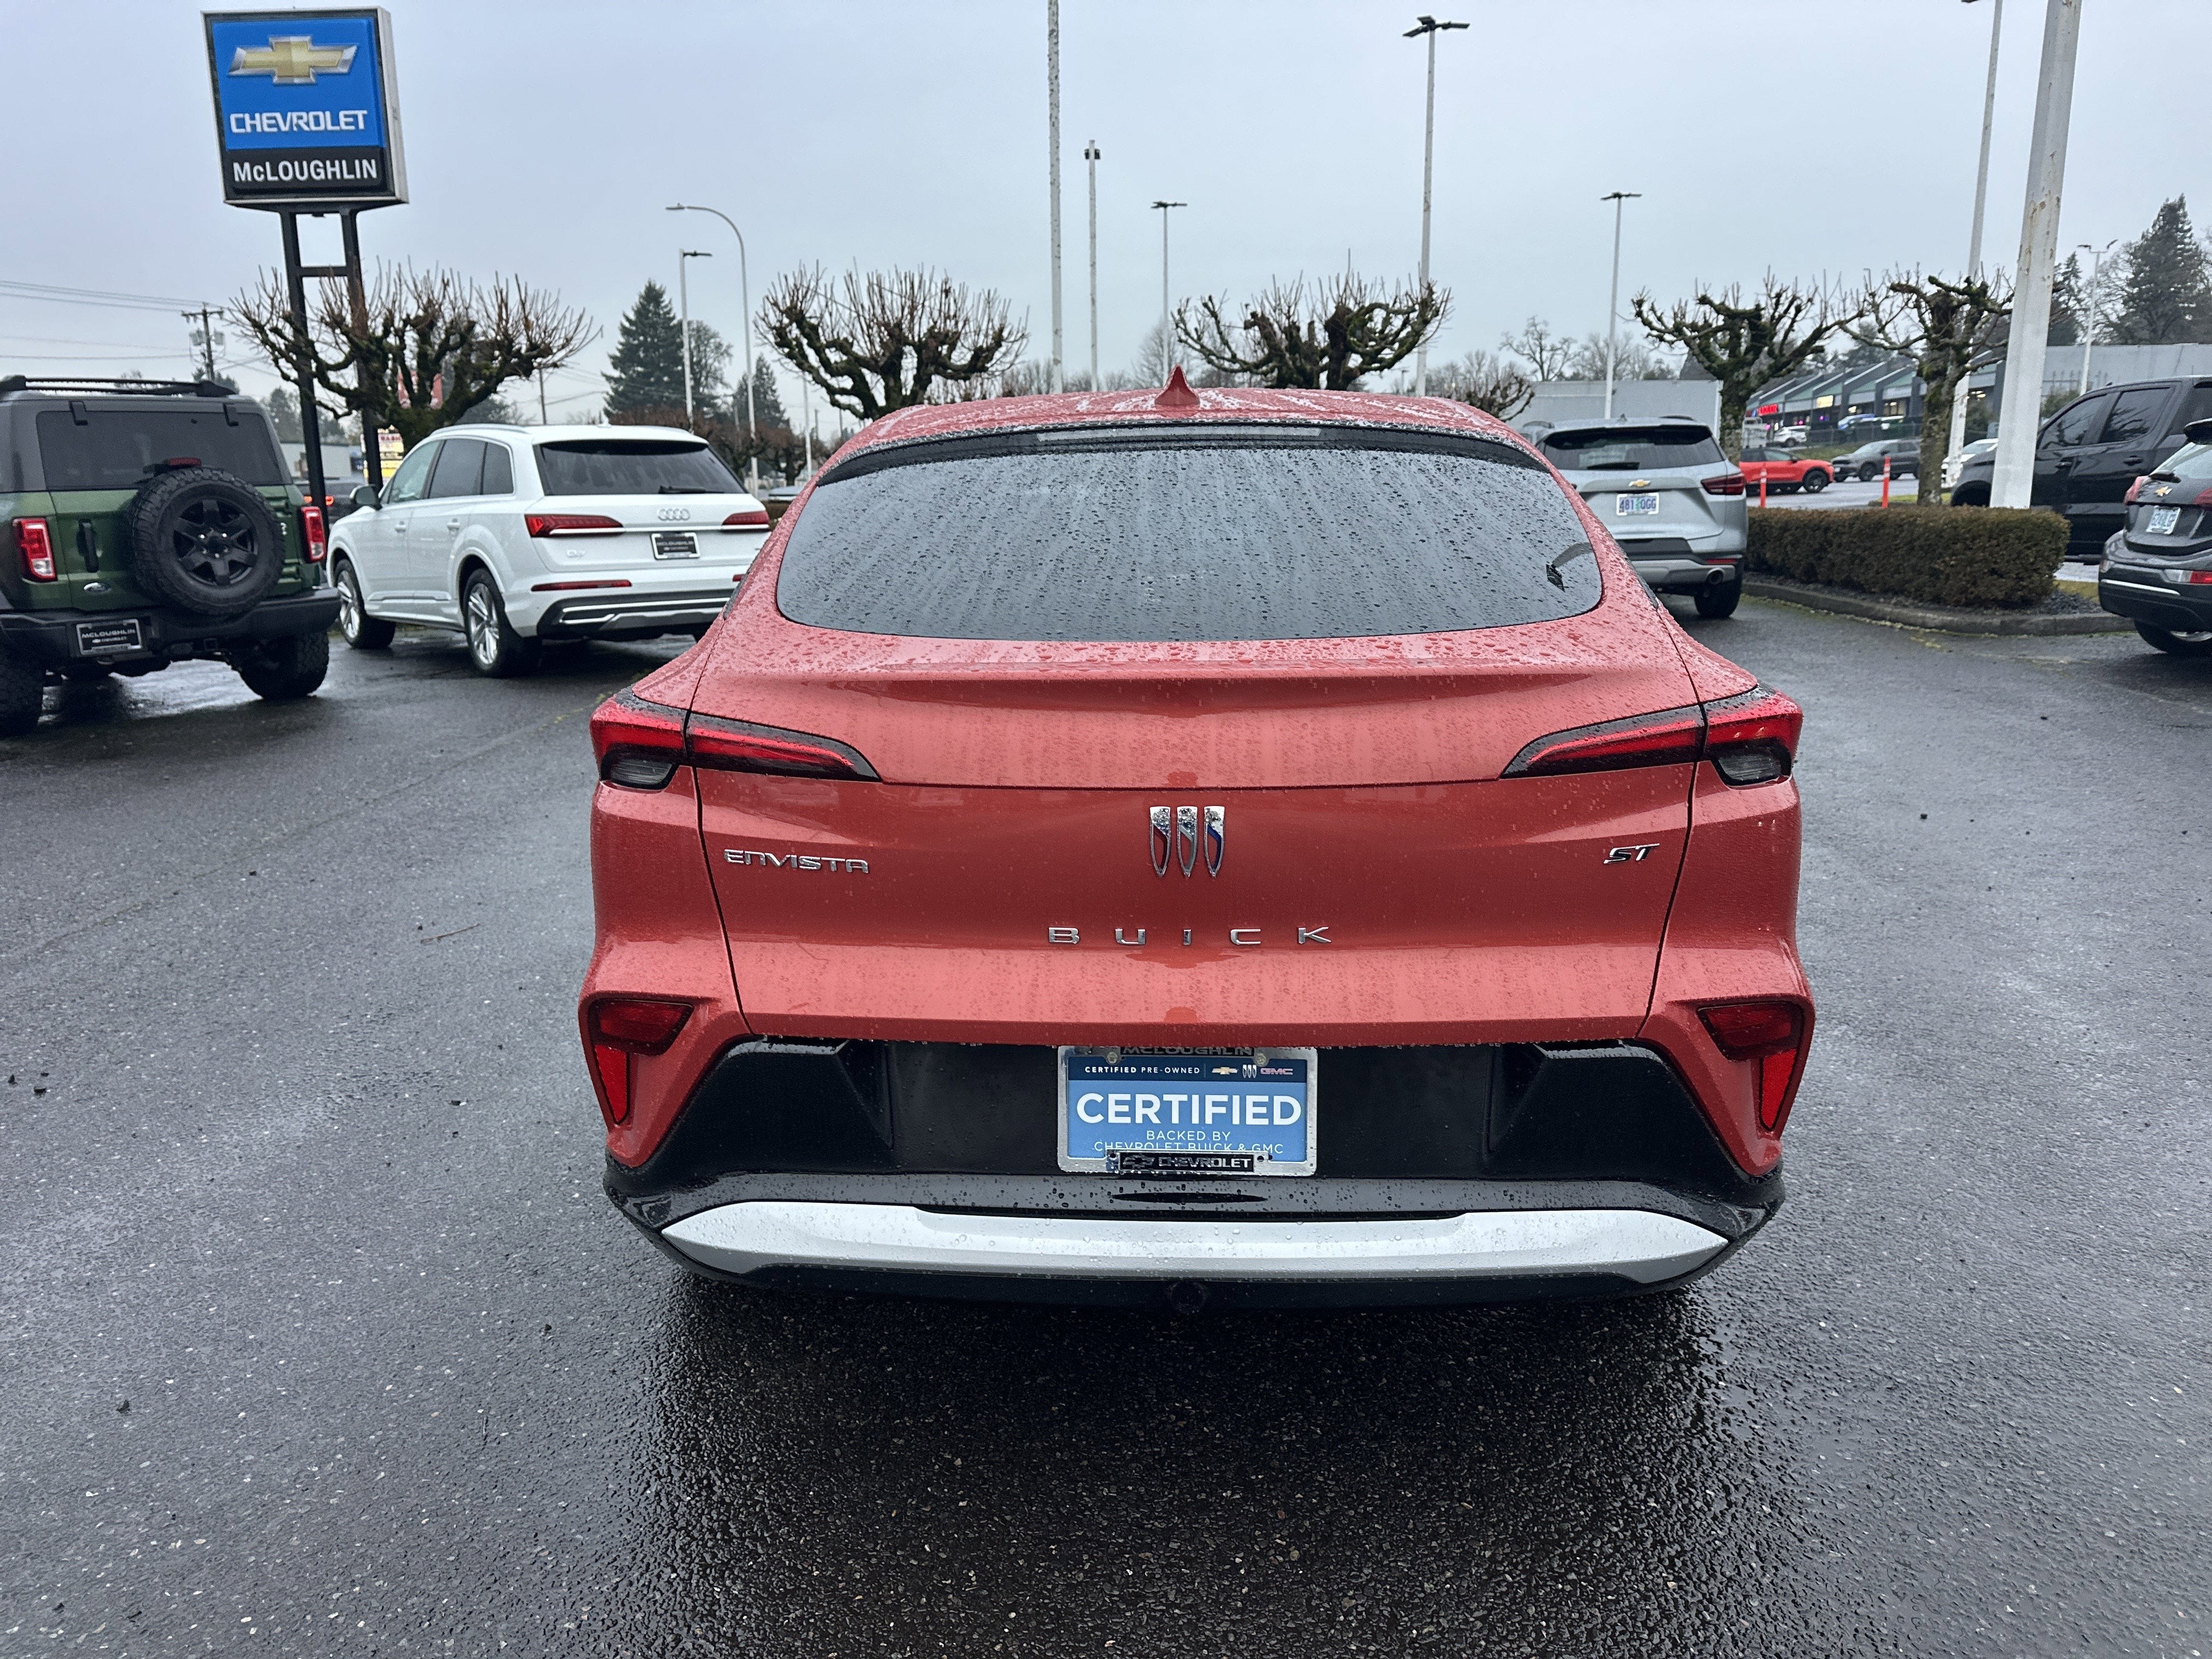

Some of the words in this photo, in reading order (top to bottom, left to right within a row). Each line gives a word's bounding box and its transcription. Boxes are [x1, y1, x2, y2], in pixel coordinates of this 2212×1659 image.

[229, 110, 368, 133] CHEVROLET
[233, 159, 377, 182] McLOUGHLIN
[724, 849, 869, 874] ENVISTA
[1603, 843, 1660, 865] ST
[1048, 927, 1332, 946] BUICK
[1076, 1093, 1302, 1125] CERTIFIED
[1147, 1130, 1206, 1141] BACKED
[1212, 1131, 1231, 1141] BY
[1251, 1143, 1284, 1154] GMC
[1158, 1156, 1251, 1168] CHEVROLET
